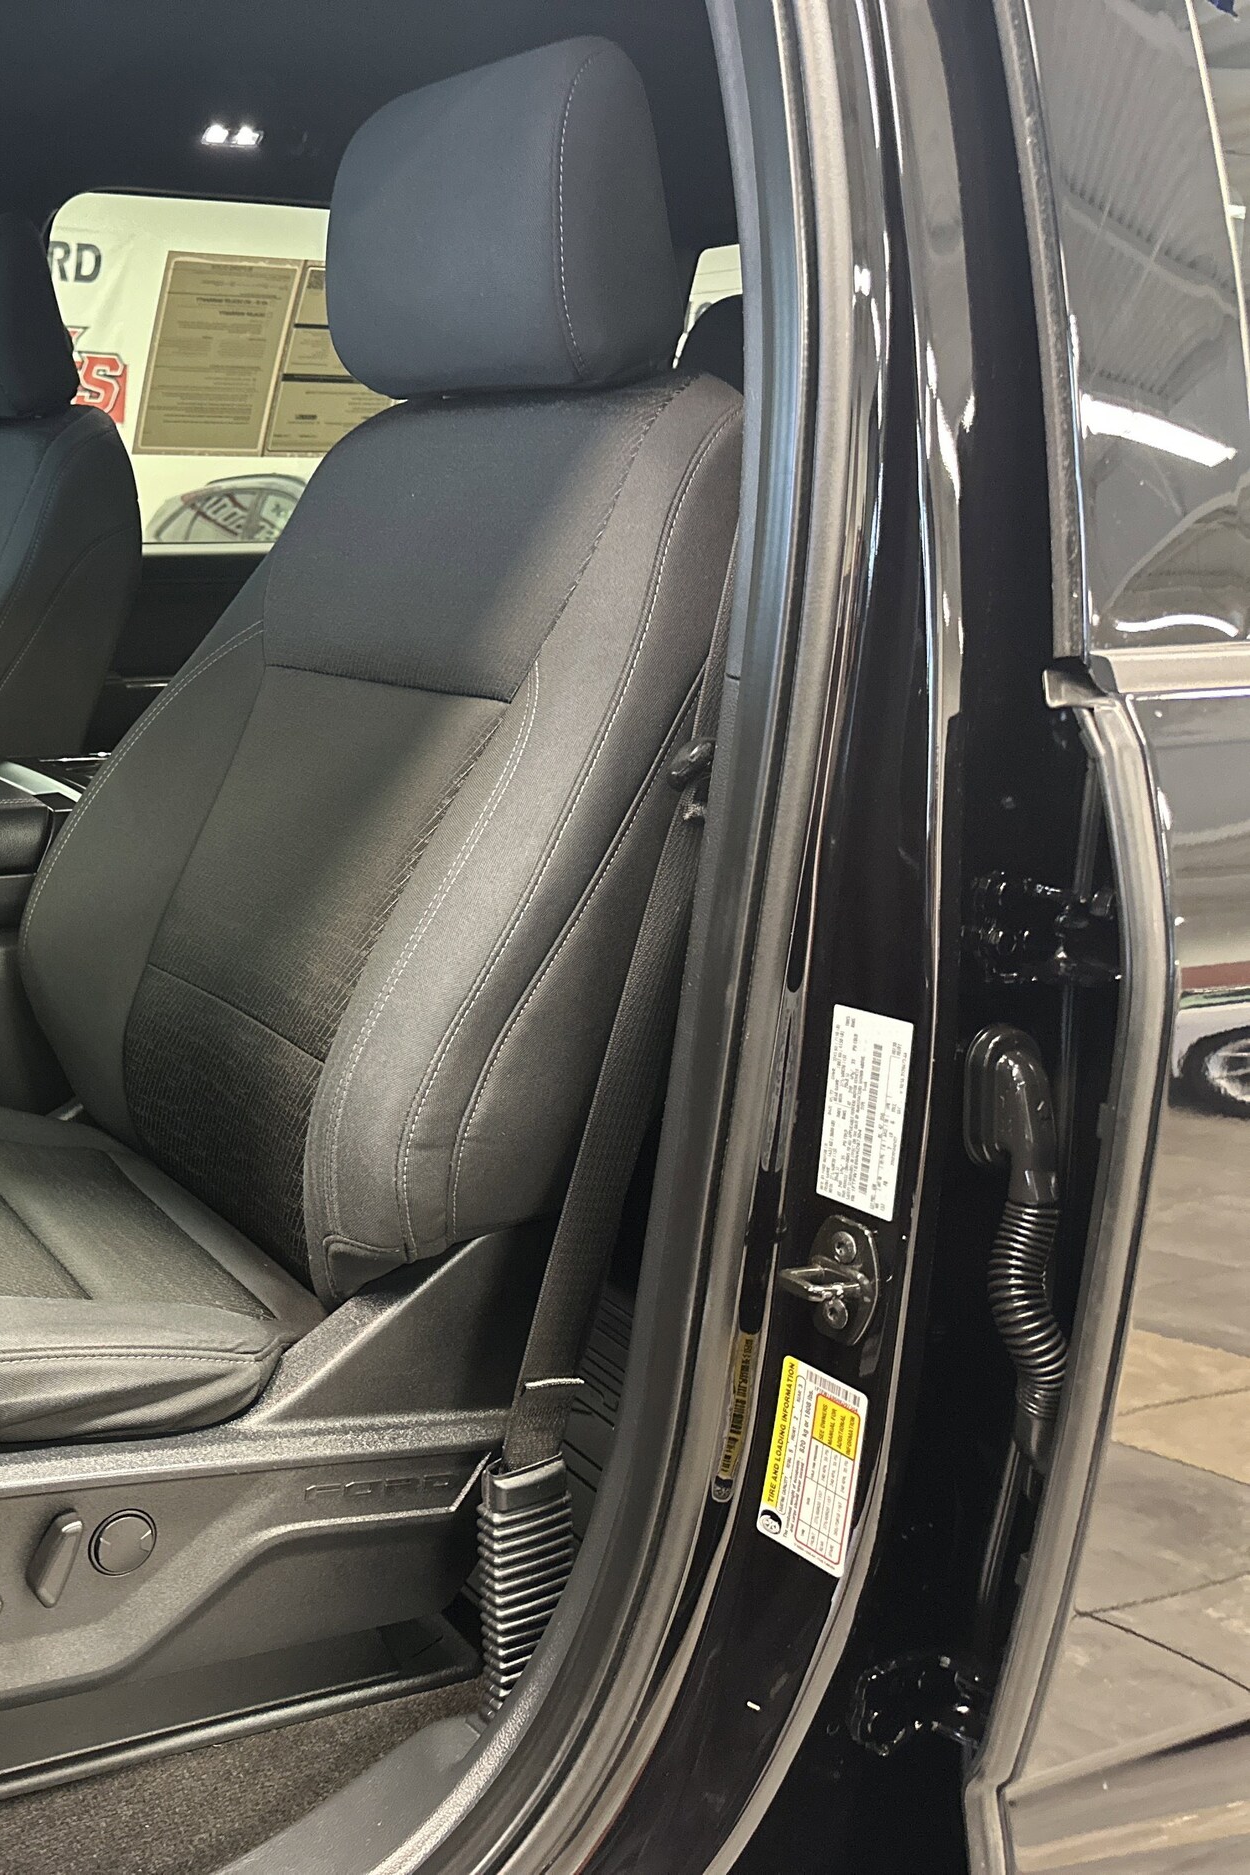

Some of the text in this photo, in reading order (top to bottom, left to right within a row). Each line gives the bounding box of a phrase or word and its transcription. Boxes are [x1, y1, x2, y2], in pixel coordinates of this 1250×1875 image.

[49, 241, 101, 283] RD
[767, 1362, 795, 1503] TIRE AND LOADING INFORMATION
[802, 1428, 809, 1438] kg
[803, 1419, 809, 1428] or
